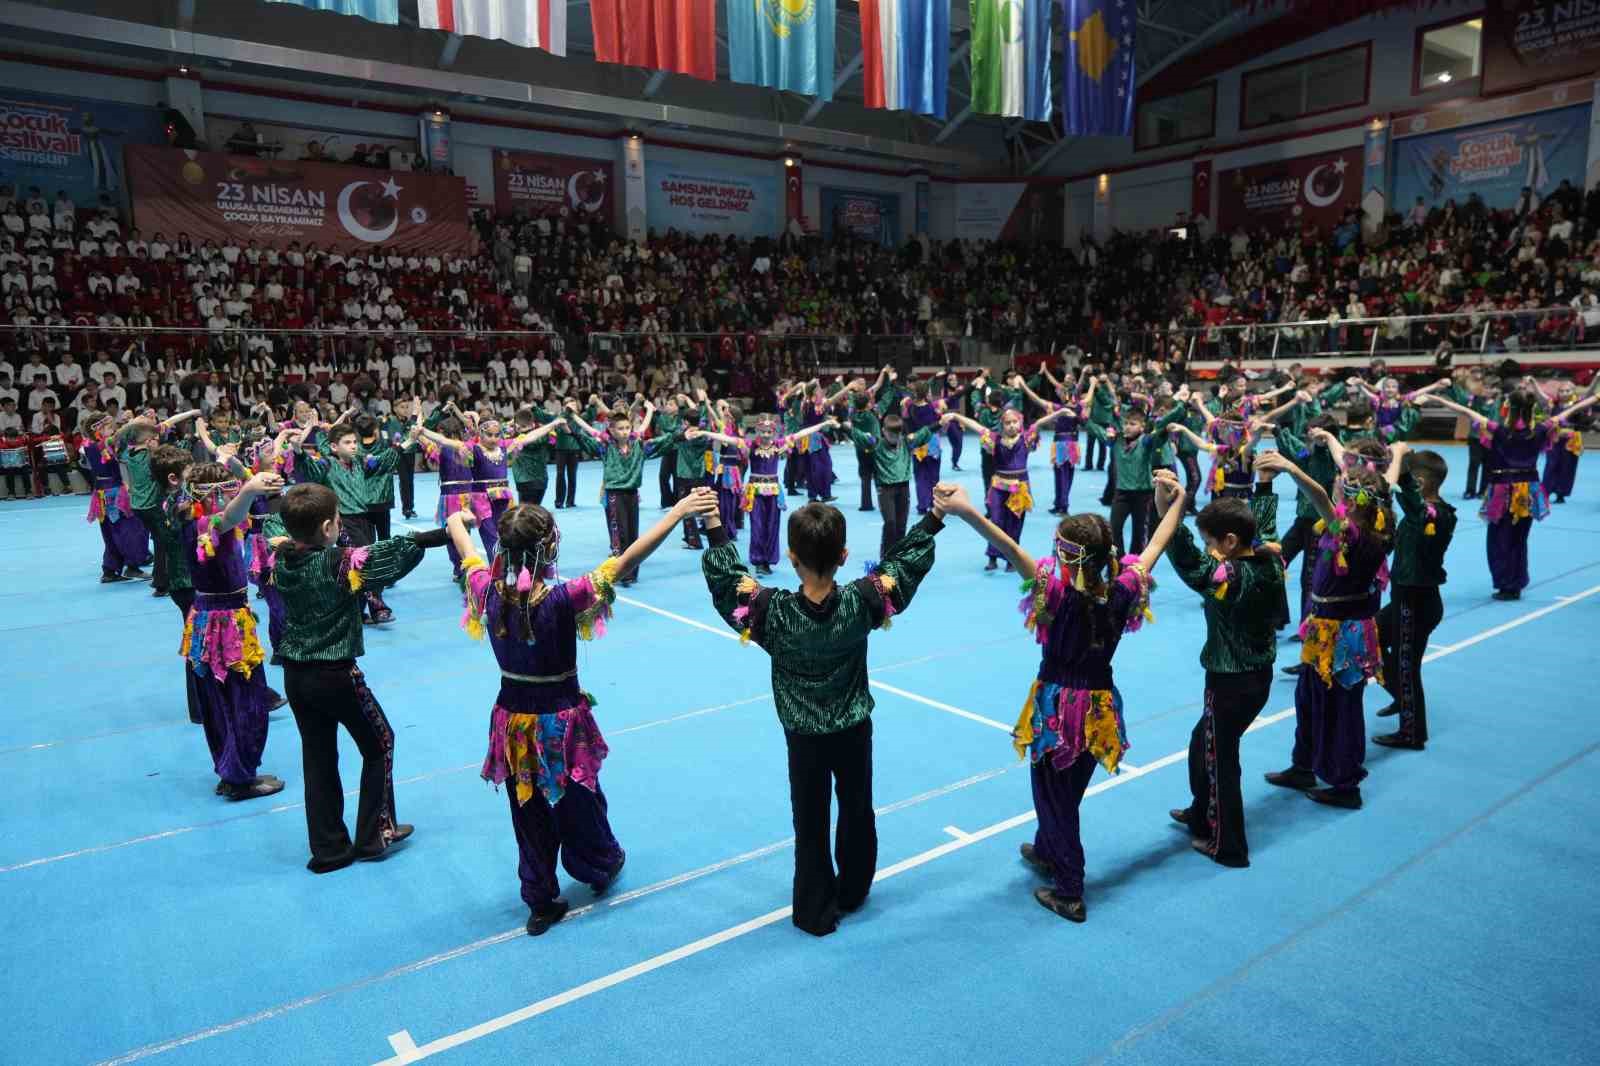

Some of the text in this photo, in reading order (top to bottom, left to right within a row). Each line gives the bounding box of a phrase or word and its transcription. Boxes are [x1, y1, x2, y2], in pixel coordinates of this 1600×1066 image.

[508, 173, 525, 187] 23
[527, 174, 566, 191] NİSAN
[216, 182, 327, 208] 23 NİSAN
[223, 211, 259, 223] ÇOCUK
